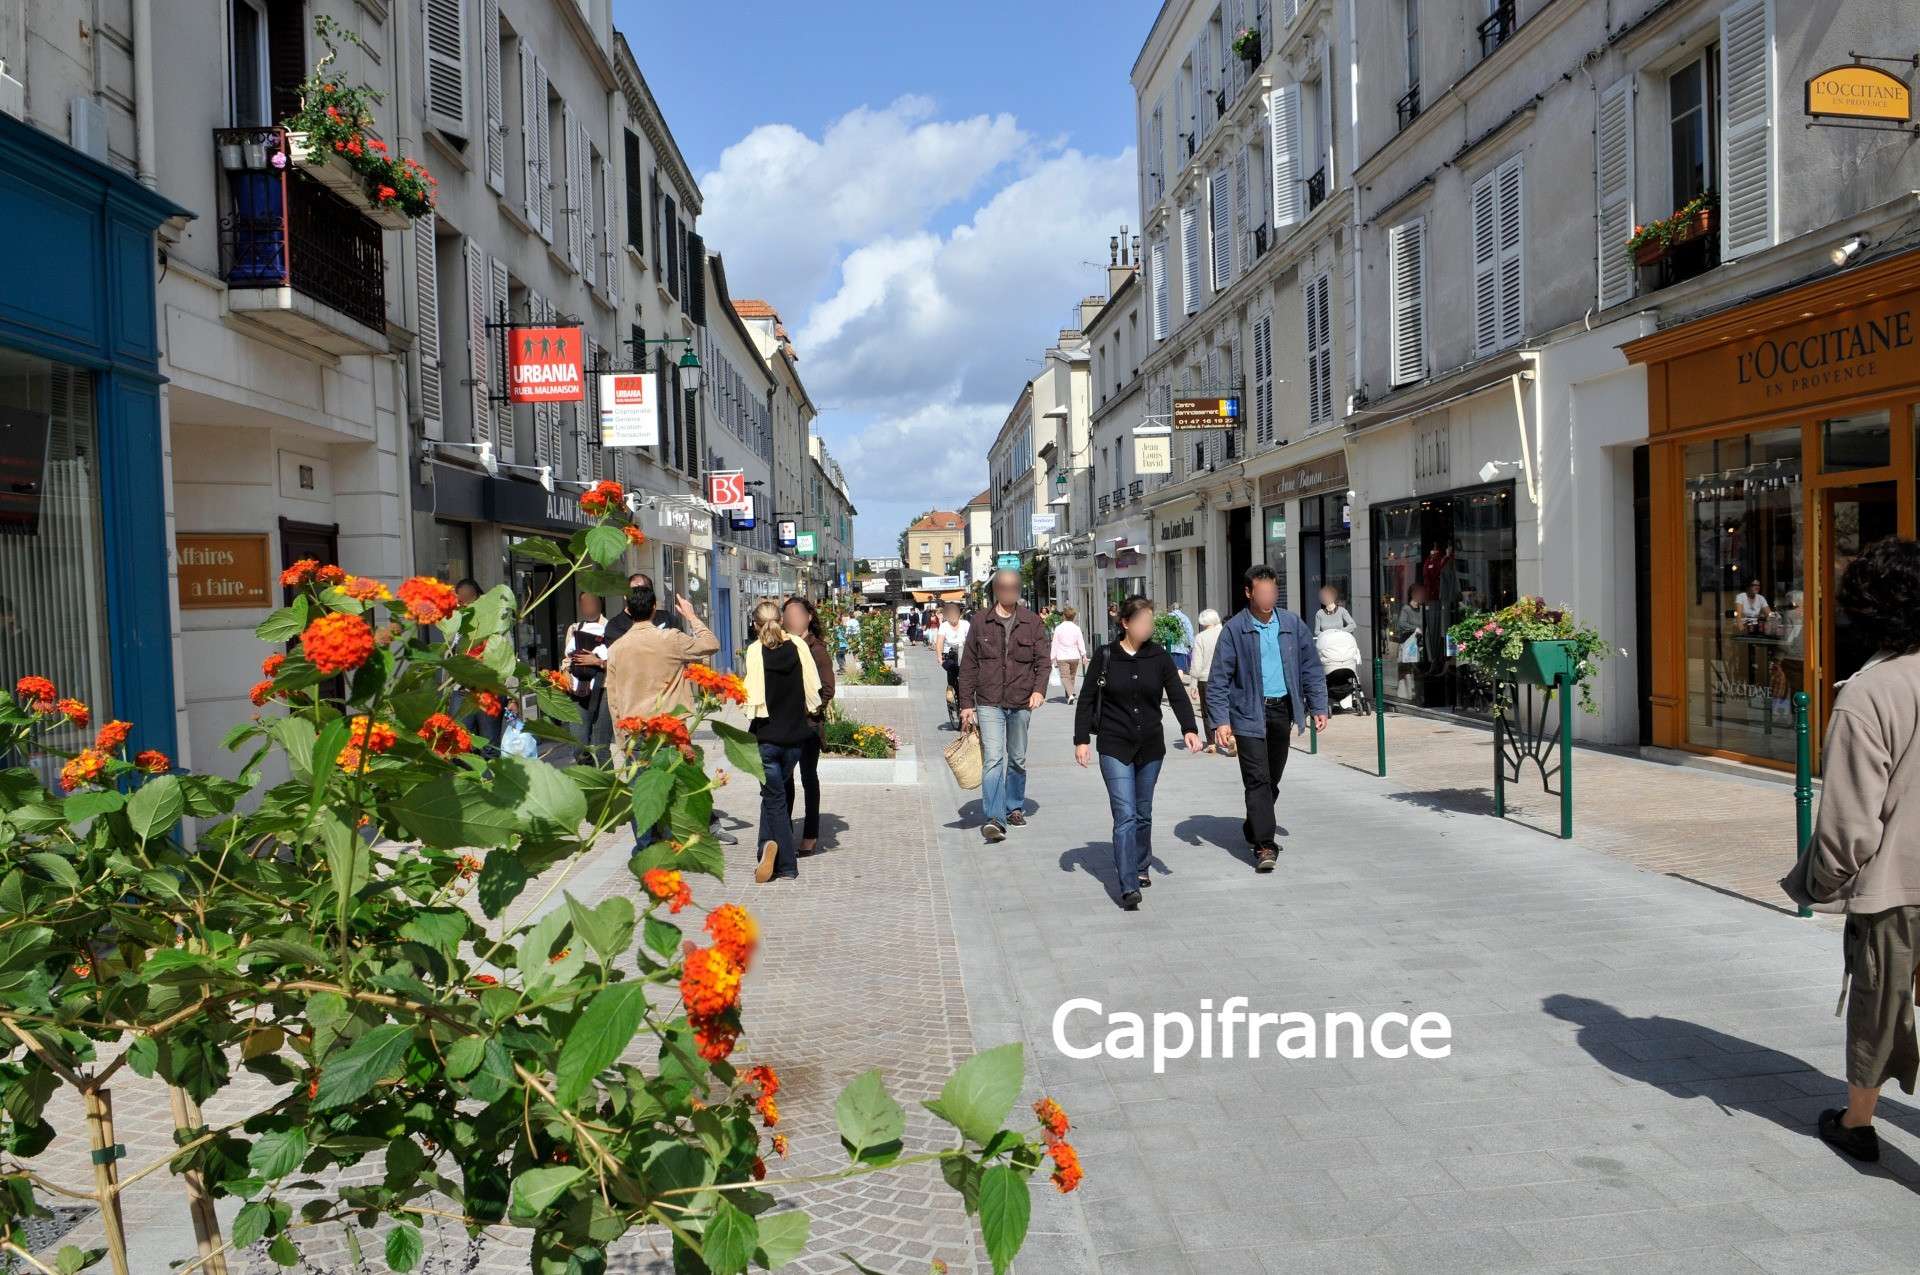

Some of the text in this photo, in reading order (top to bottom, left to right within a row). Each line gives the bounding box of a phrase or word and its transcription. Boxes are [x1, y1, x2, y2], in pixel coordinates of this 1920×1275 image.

[1816, 80, 1903, 100] L'OCCITANE
[1846, 99, 1888, 108] PROVENCE
[1737, 311, 1913, 384] L'OCCITANE
[513, 363, 578, 384] URBANIA
[1766, 361, 1877, 399] EN PROVENCE
[514, 385, 579, 395] RUEIL MALMAISON
[616, 390, 641, 398] URBANIA
[1142, 442, 1159, 451] Jean
[1142, 452, 1163, 460] Louis
[546, 494, 573, 522] ALAIN
[206, 578, 245, 596] faire
